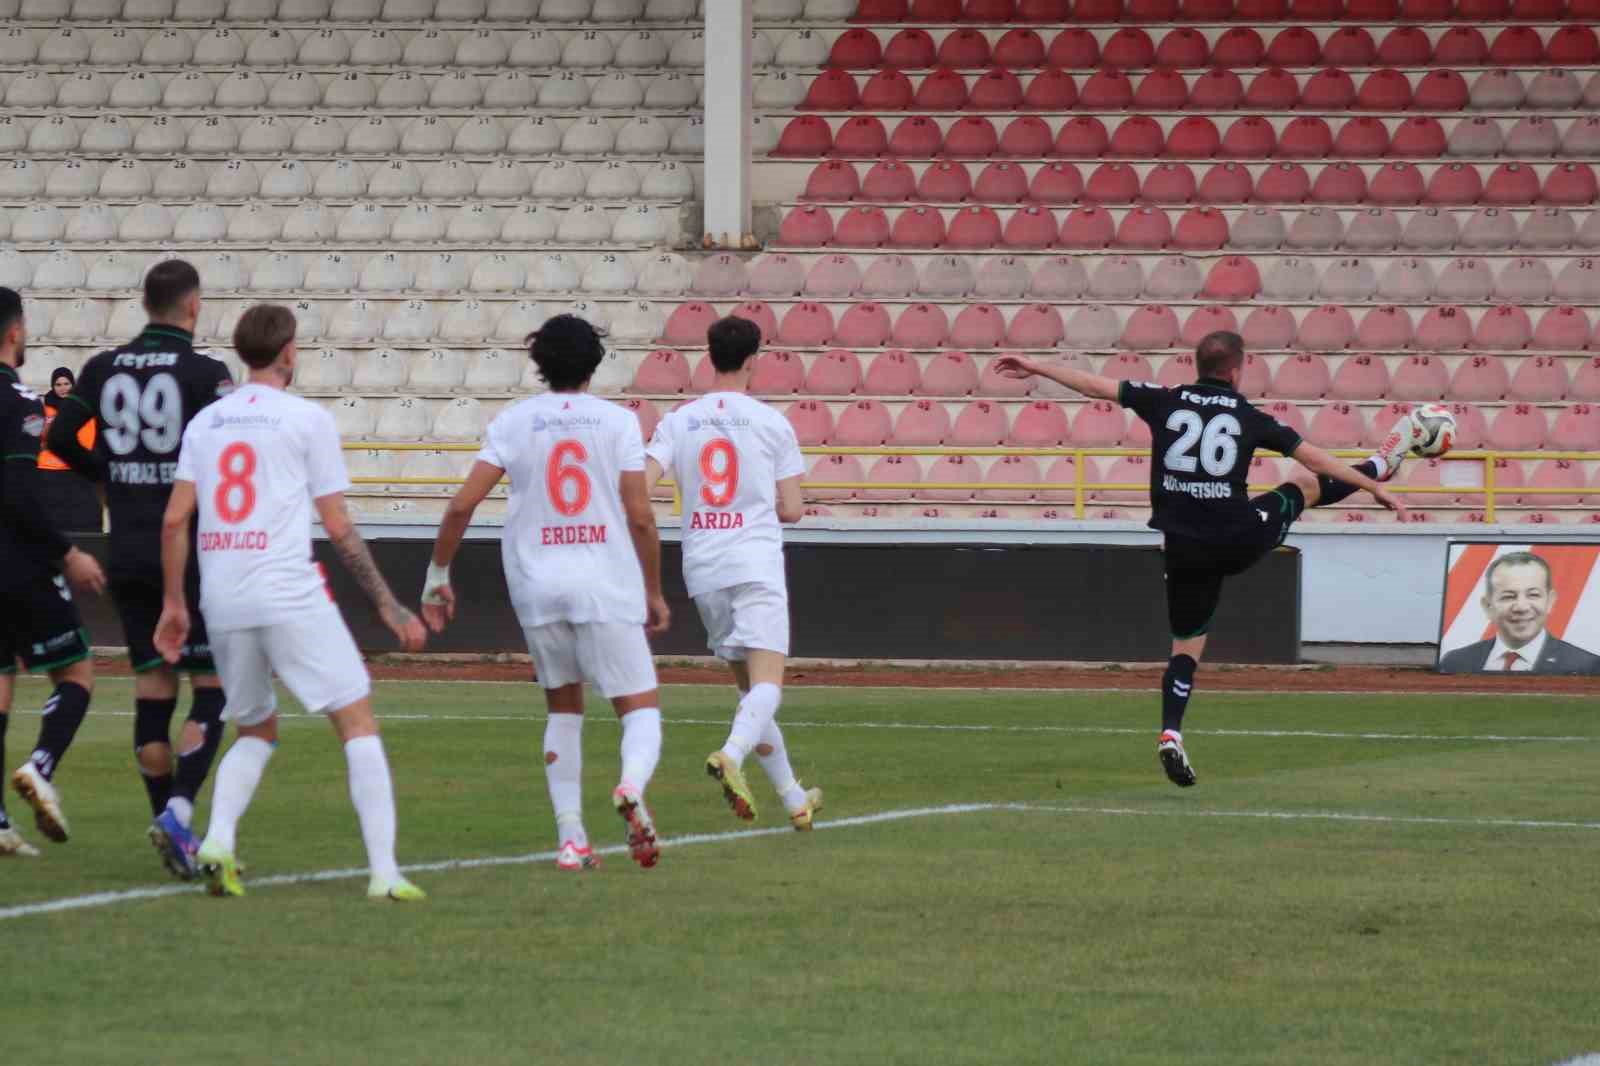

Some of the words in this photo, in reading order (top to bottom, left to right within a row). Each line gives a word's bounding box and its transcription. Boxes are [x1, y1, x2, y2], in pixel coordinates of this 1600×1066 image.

[101, 372, 181, 455] 99
[1163, 409, 1241, 477] 26
[214, 441, 257, 515] 8
[545, 439, 592, 517] 6
[699, 438, 738, 507] 9
[541, 525, 607, 545] ERDEM
[691, 511, 744, 529] ARDA
